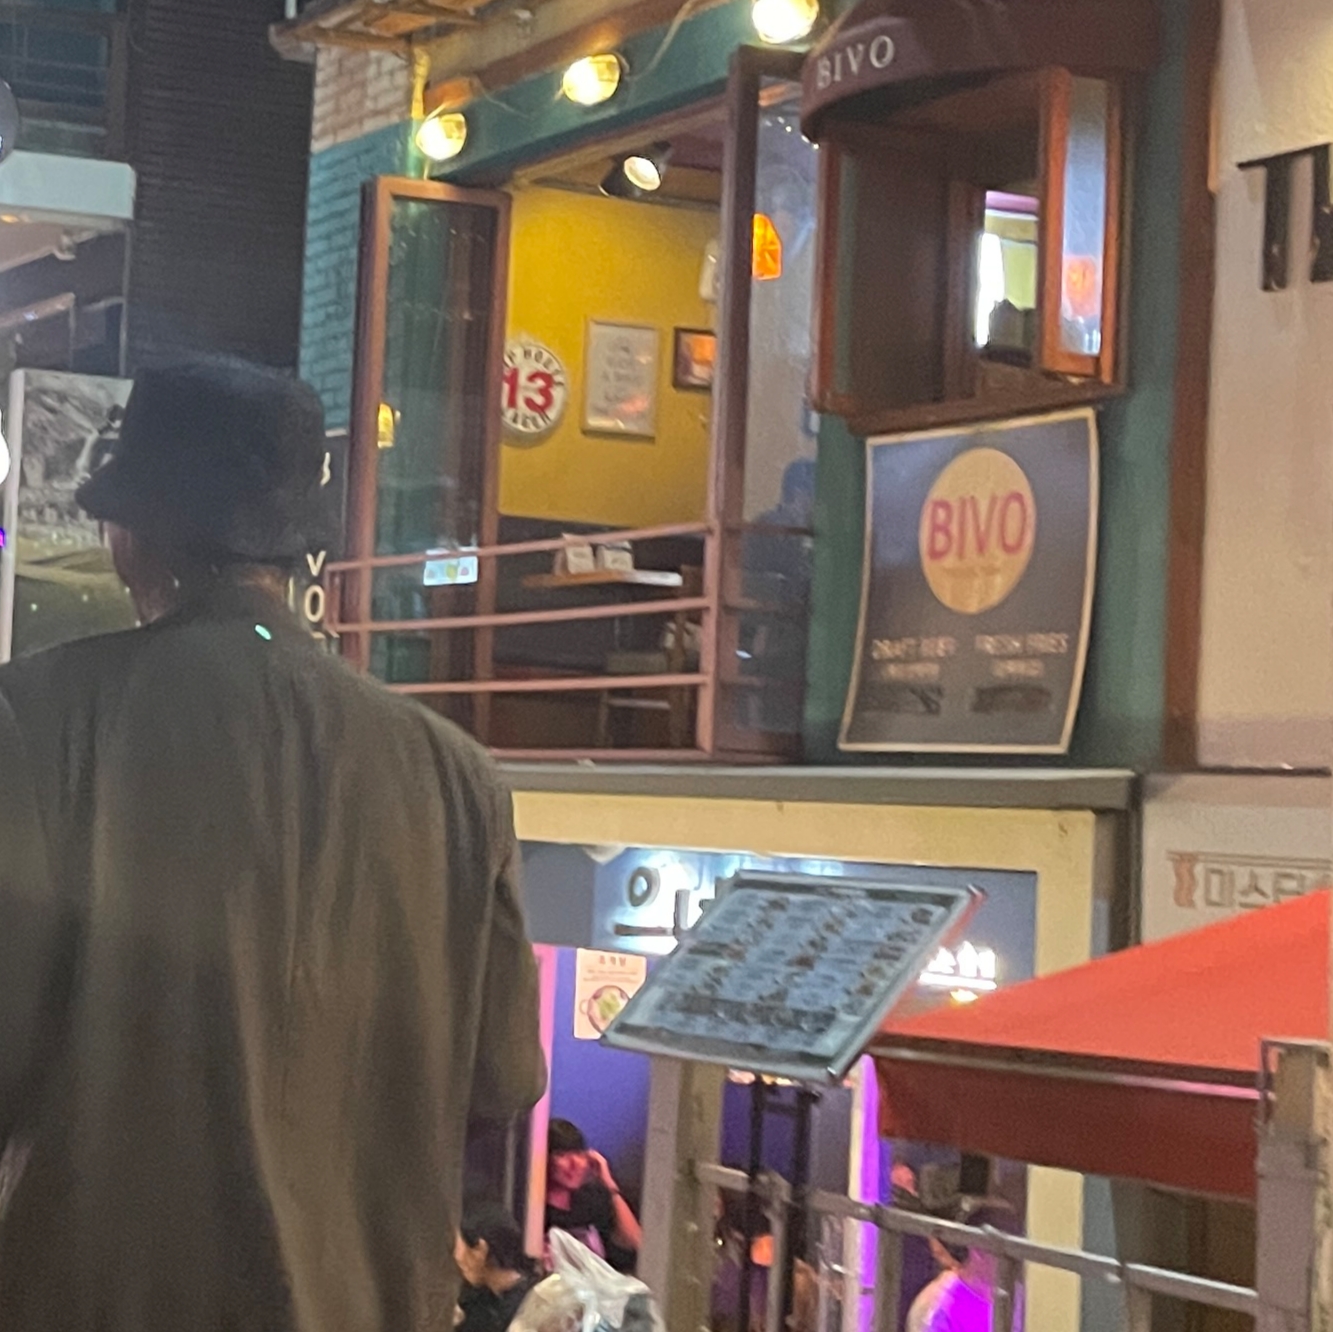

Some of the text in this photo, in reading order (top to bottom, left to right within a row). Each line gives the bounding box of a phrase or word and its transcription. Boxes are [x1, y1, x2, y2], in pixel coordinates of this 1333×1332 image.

[816, 34, 896, 90] BIVO
[503, 367, 554, 412] 13
[927, 491, 1028, 561] BIVO
